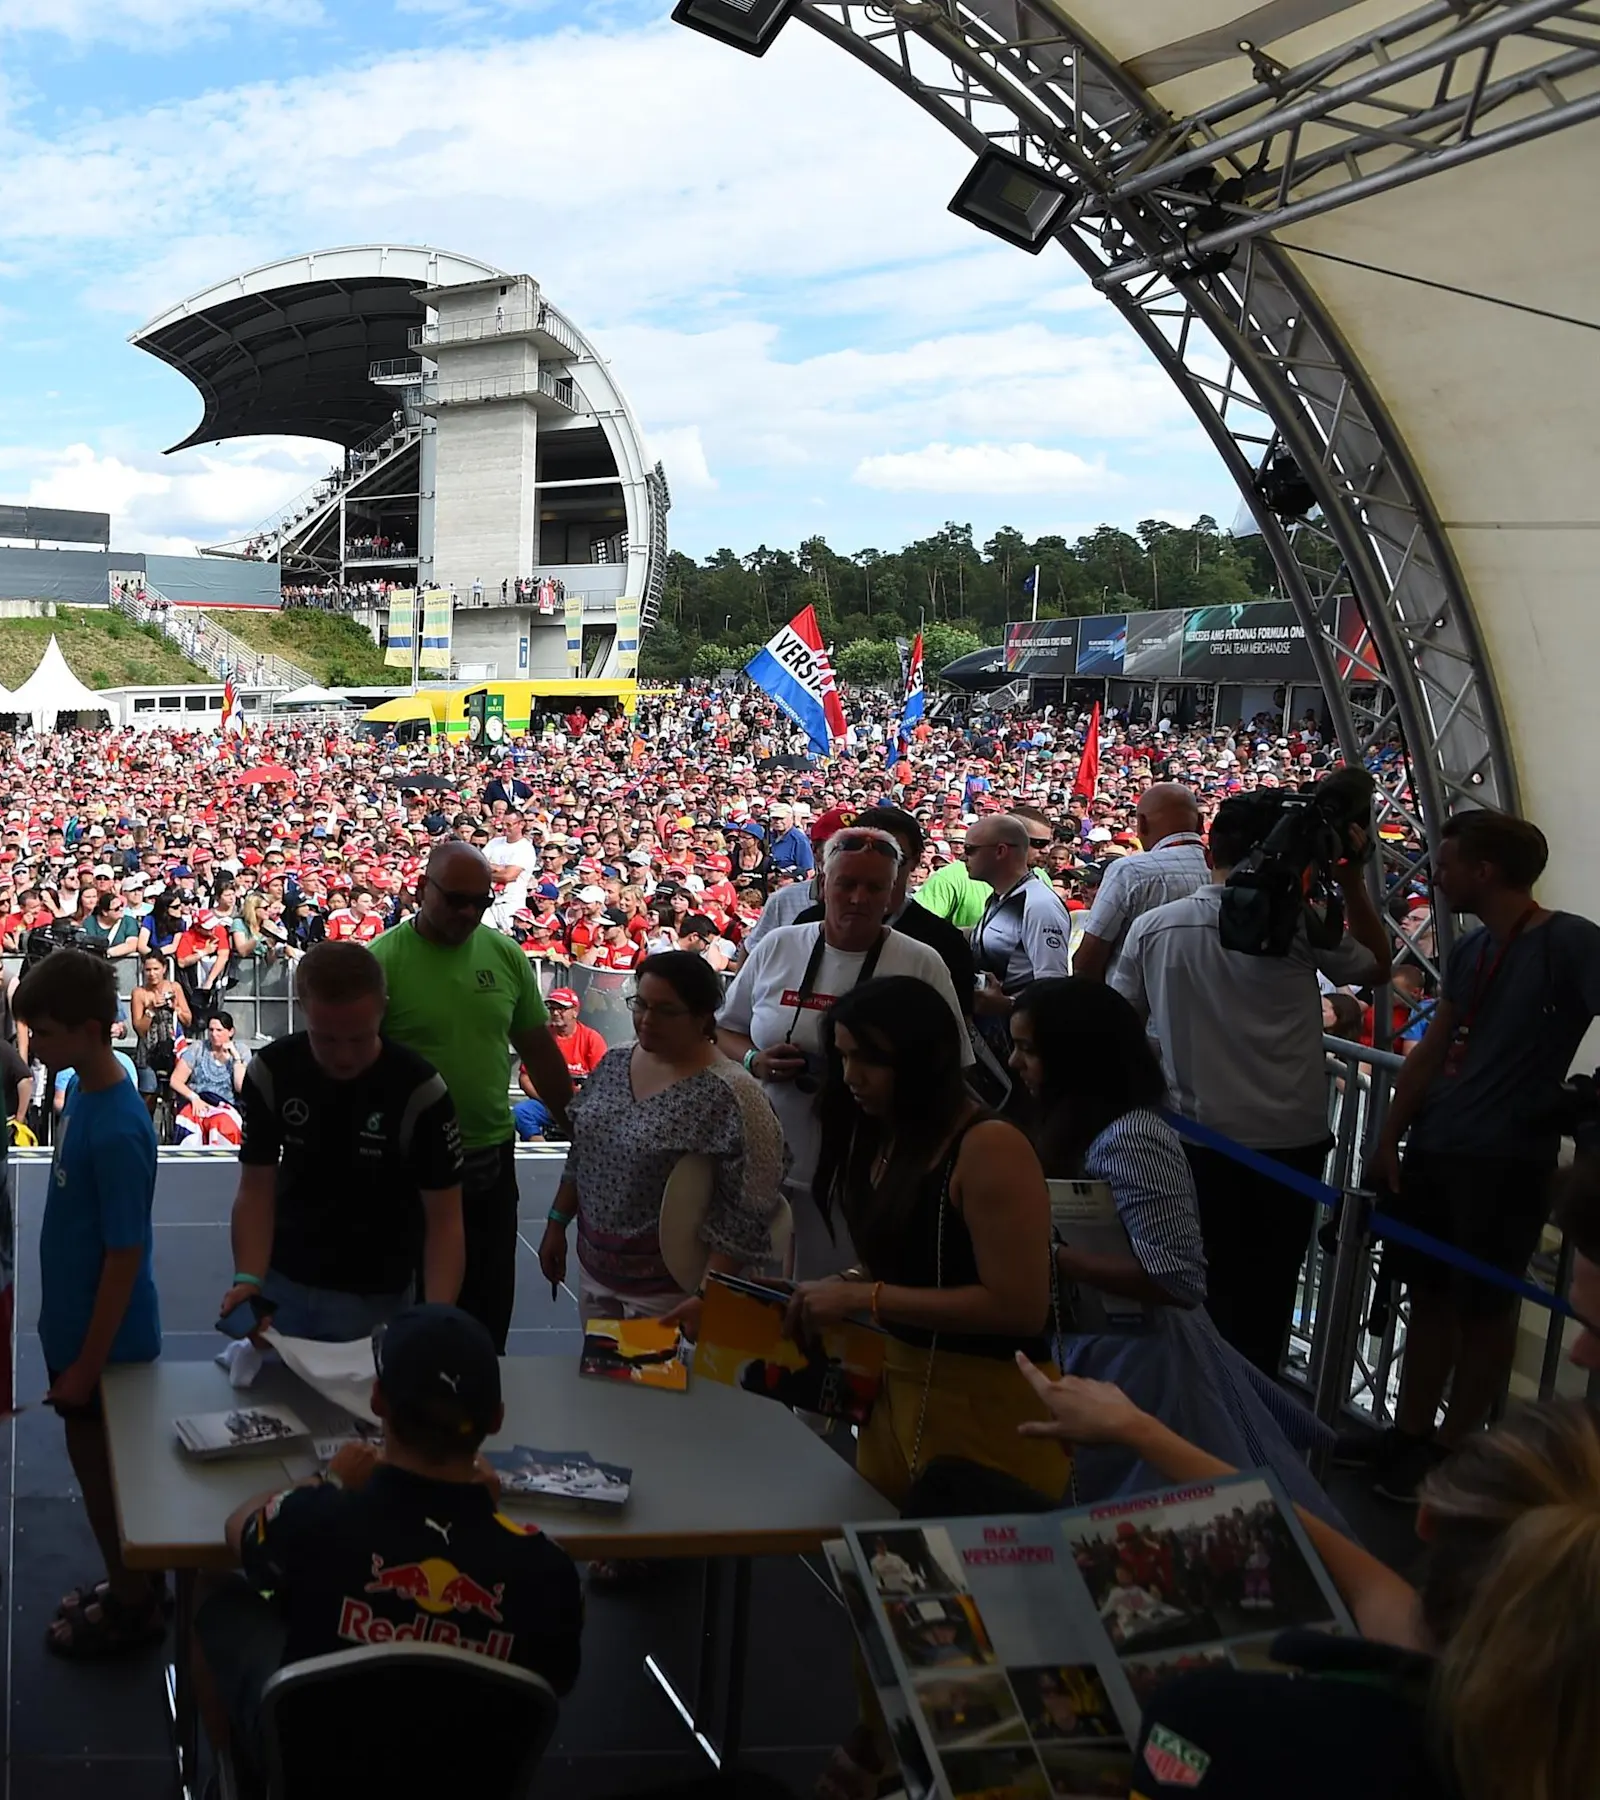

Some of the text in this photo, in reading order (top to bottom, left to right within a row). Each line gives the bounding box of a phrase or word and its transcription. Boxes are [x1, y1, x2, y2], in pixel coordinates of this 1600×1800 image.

[1185, 625, 1305, 642] MERCEDES AMG PETRONAS FORMULA ONE
[1210, 641, 1291, 655] OFFICIAL TEAM MERCHANDISE
[338, 1596, 428, 1645] Red
[1153, 1728, 1202, 1771] TAG
